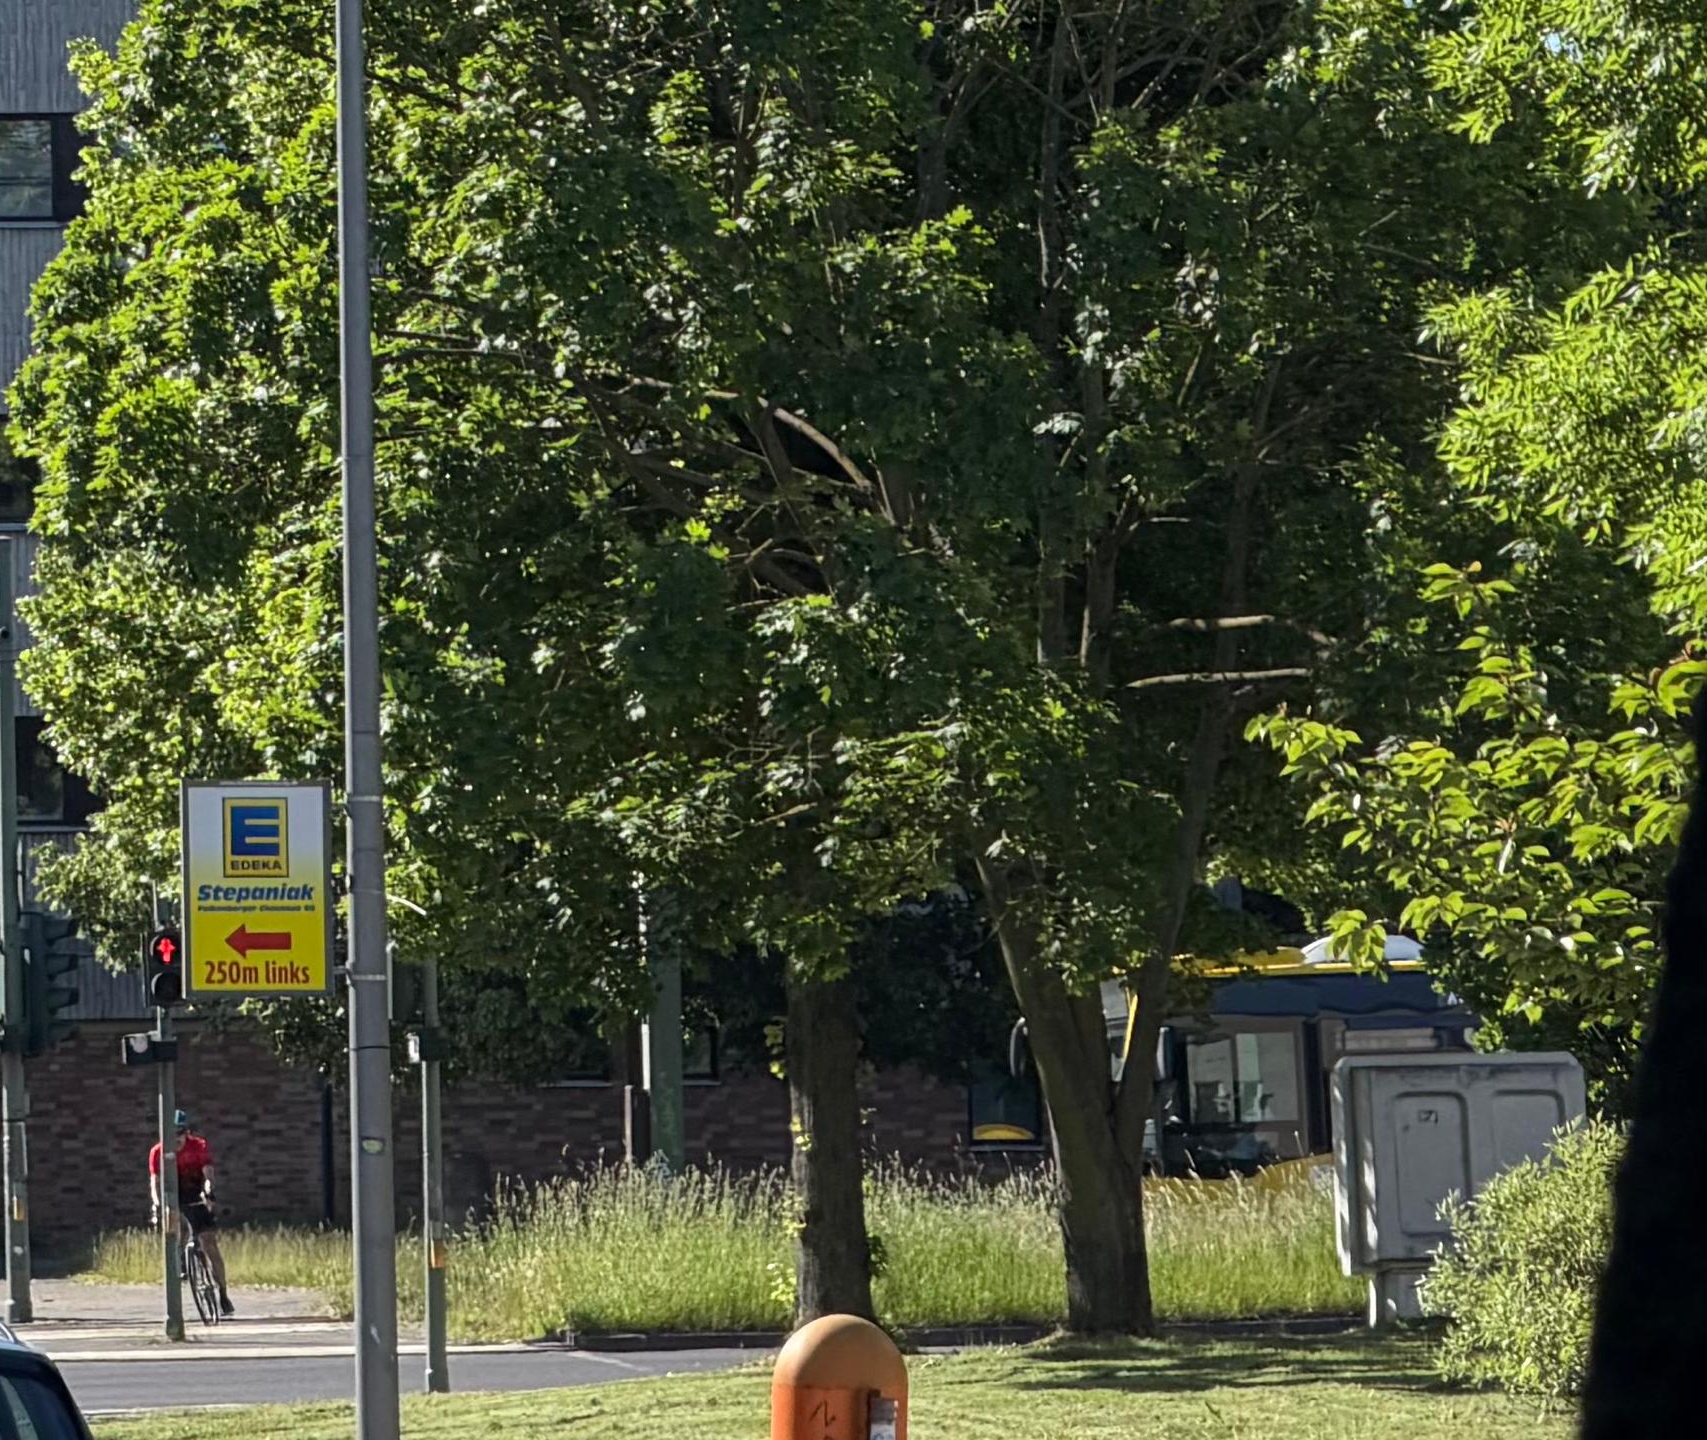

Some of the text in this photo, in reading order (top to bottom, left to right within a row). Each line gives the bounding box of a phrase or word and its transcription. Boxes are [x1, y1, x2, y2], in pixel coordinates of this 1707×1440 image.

[230, 860, 283, 871] EDEKA
[197, 882, 315, 903] Stepaniak
[205, 960, 310, 985] 250m links
